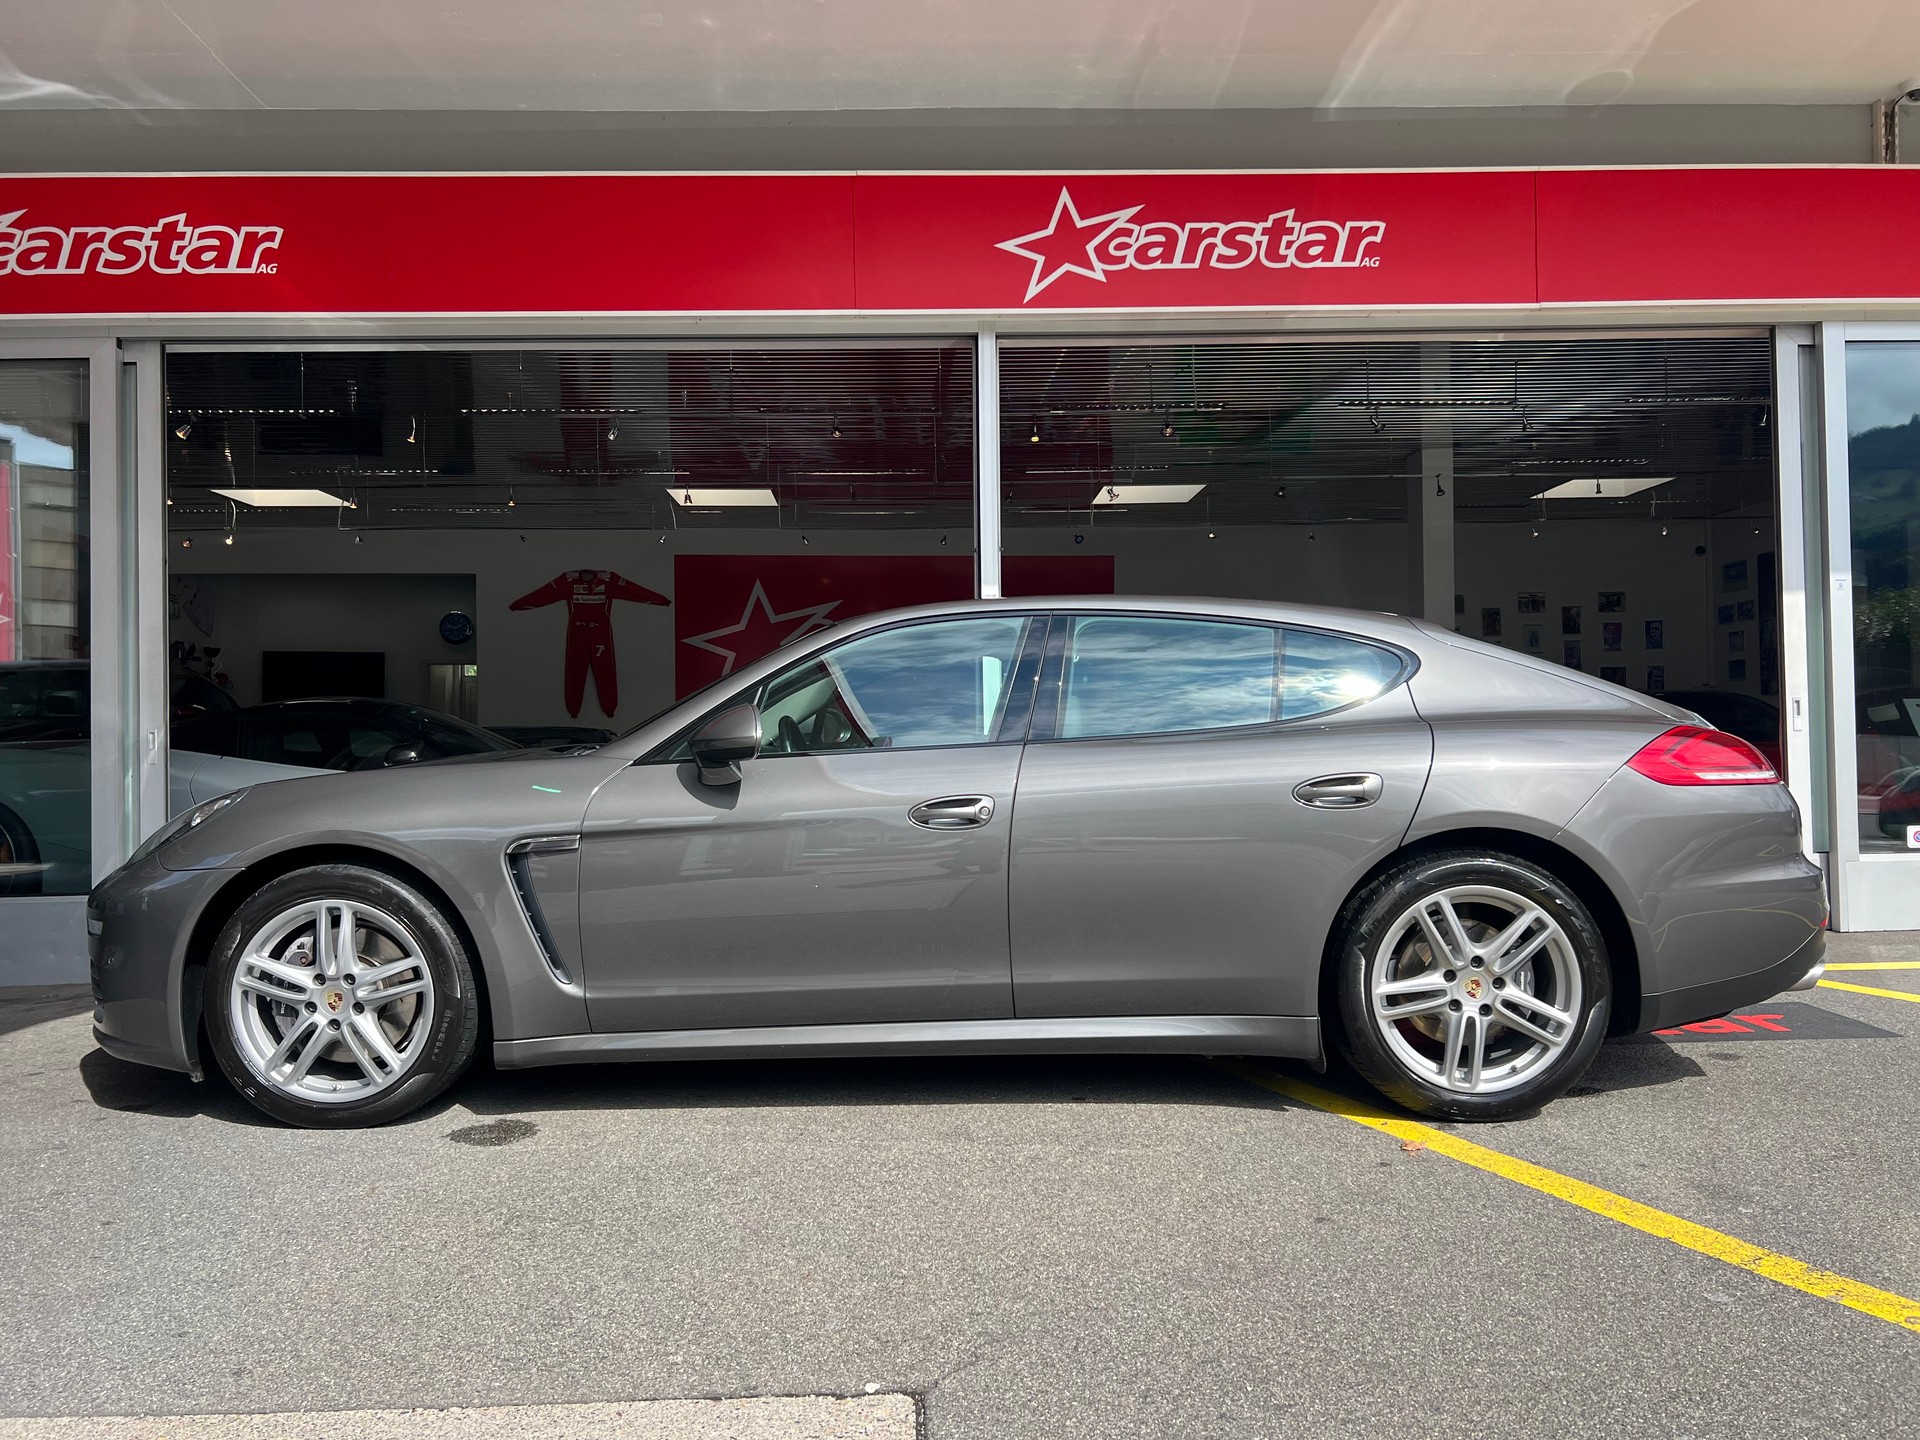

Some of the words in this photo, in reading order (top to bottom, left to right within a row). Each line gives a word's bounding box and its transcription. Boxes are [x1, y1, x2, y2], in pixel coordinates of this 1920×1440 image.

[1087, 208, 1386, 271] carstar
[1360, 256, 1380, 268] AG
[257, 263, 278, 274] AG
[595, 644, 606, 657] 7
